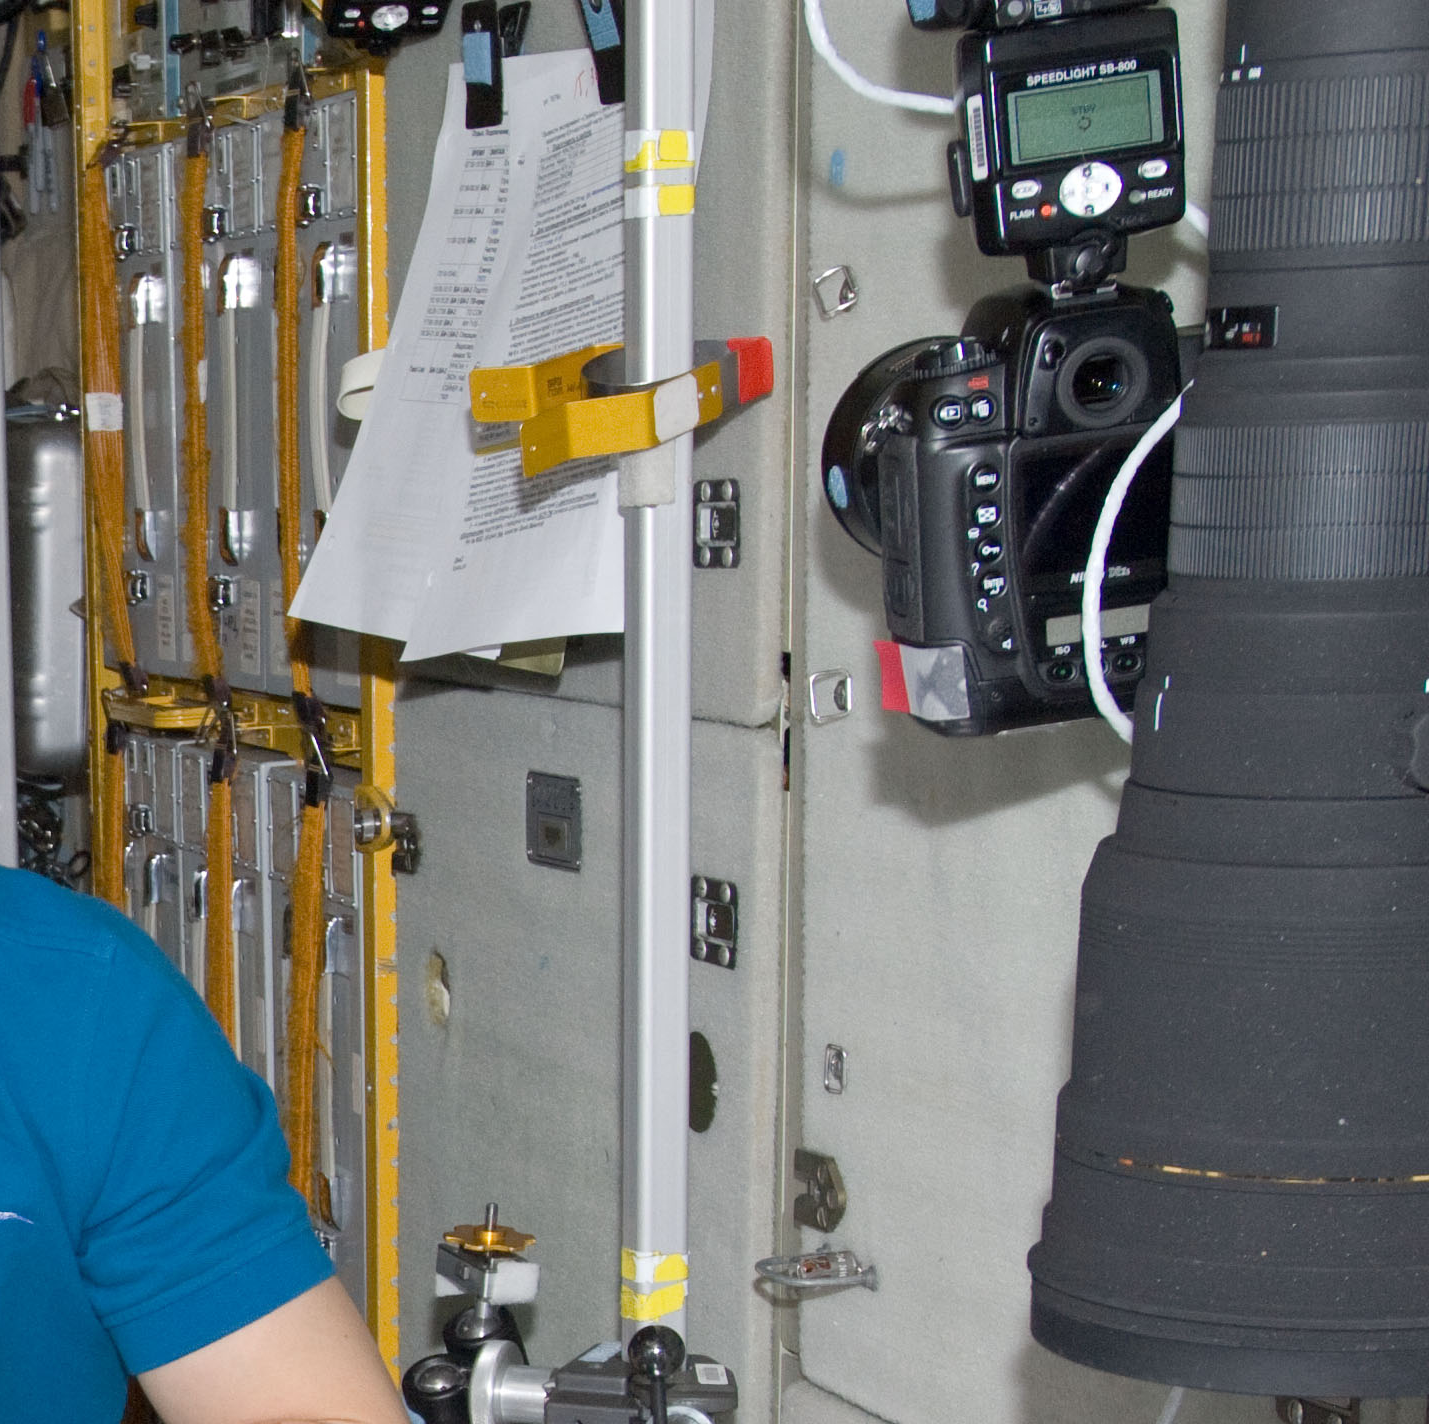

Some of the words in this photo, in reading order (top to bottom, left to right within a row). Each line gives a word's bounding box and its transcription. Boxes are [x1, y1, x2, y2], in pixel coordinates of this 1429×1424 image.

[1026, 66, 1097, 87] SPEEDLIGHT
[1147, 188, 1174, 199] READY
[1009, 209, 1035, 221] FLASH
[975, 472, 997, 486] MENU
[1120, 635, 1136, 646] WB
[1055, 644, 1071, 656] ISO
